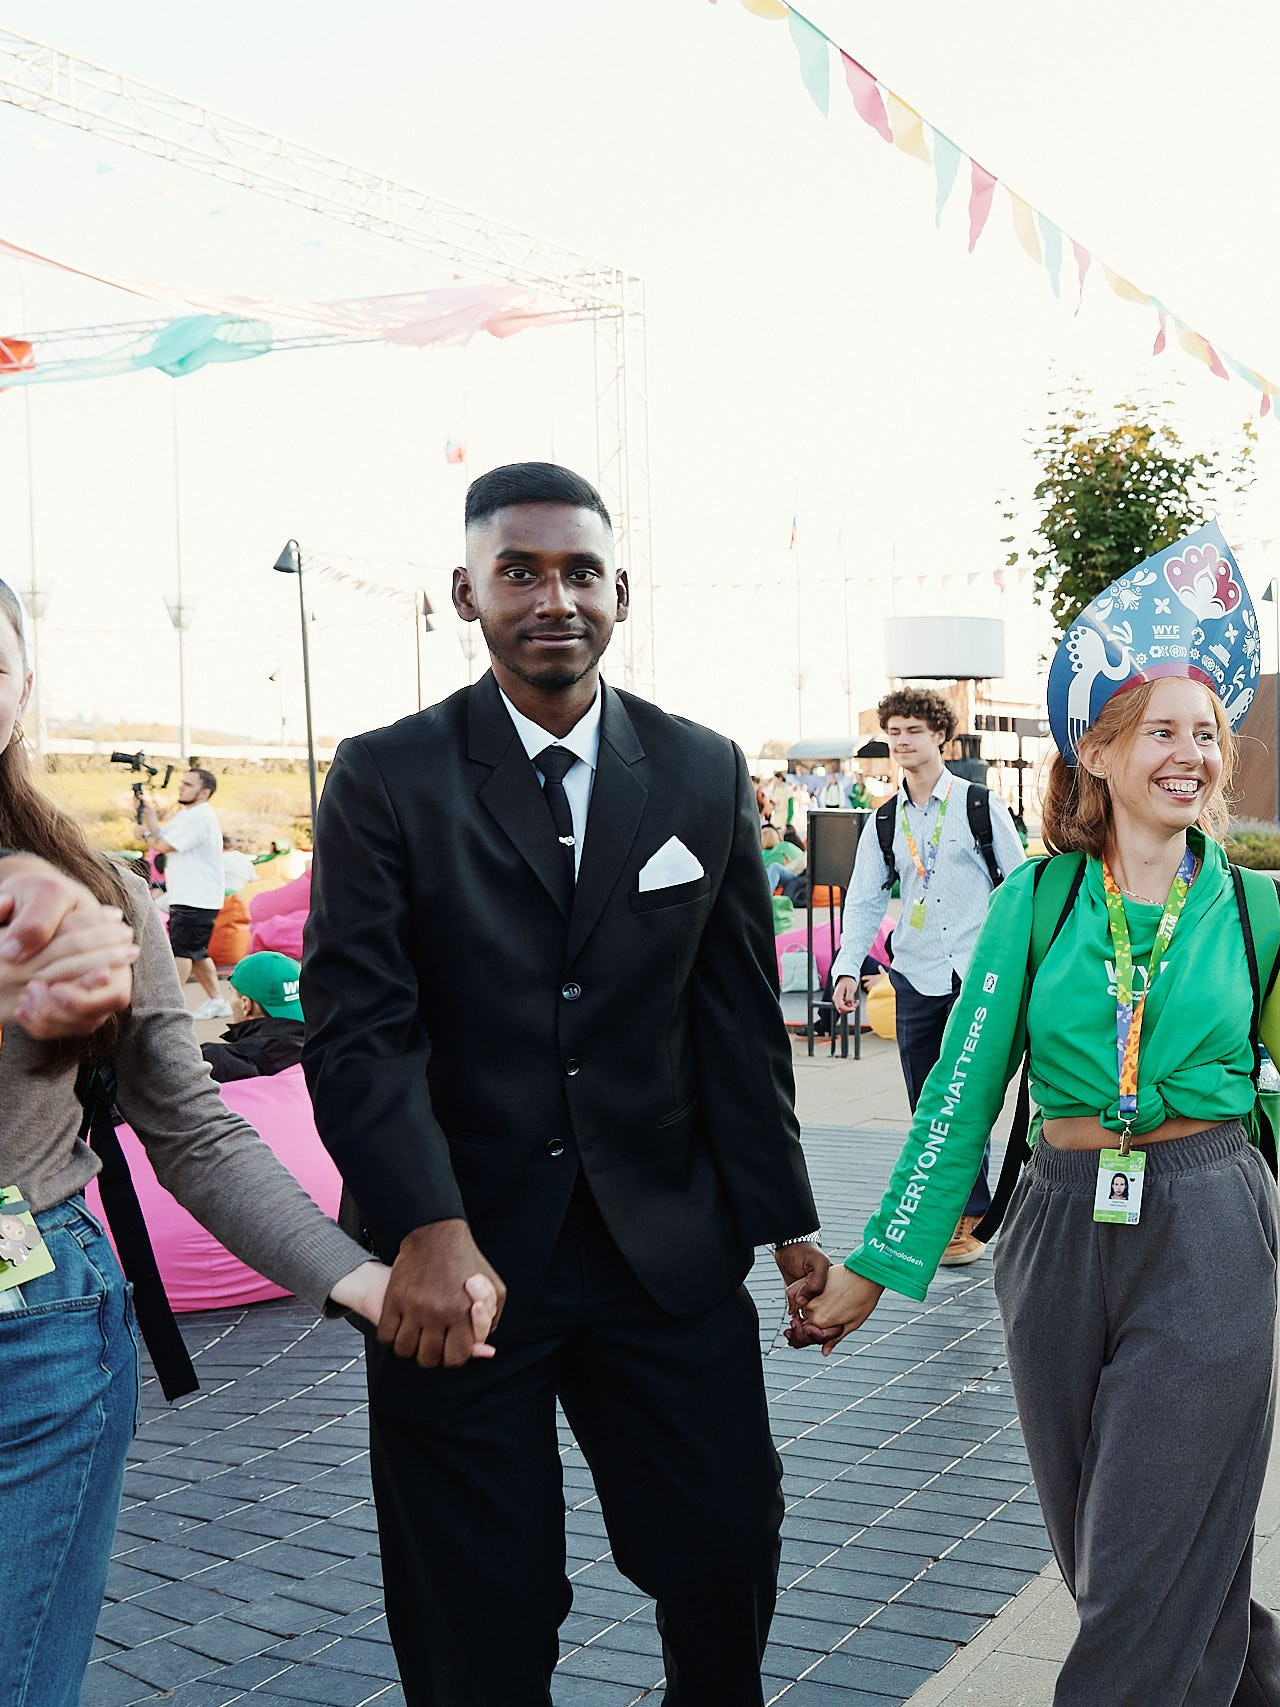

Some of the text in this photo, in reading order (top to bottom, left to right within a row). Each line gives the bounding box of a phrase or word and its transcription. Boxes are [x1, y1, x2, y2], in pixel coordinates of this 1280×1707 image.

[1152, 624, 1180, 635] WYF
[1163, 914, 1179, 941] WYF
[885, 1006, 988, 1243] EVERYONE MATTERS
